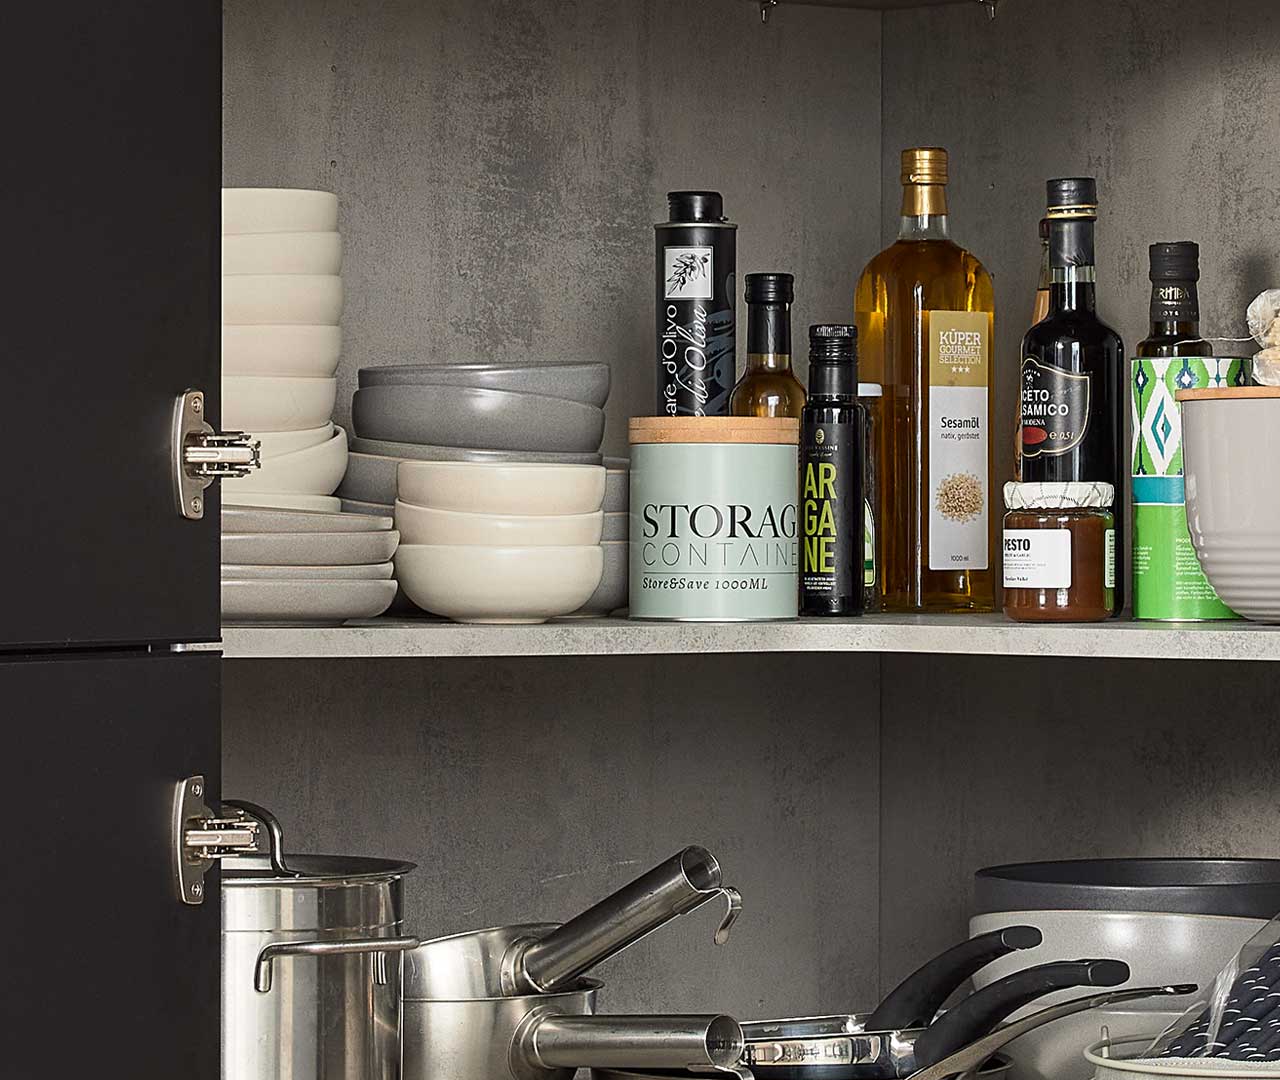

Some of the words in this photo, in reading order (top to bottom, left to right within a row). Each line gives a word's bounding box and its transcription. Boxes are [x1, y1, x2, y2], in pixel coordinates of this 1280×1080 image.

[662, 304, 678, 374] d'Olivo
[676, 304, 707, 371] Oliva
[939, 345, 981, 354] GOURMET
[939, 355, 981, 364] SELECTION
[663, 382, 677, 417] are
[1022, 389, 1050, 402] CETO
[1022, 403, 1069, 416] SAMICO
[940, 416, 980, 429] Sesamöl
[804, 462, 838, 499] AR
[642, 503, 799, 539] STORAG
[804, 499, 838, 536] GA
[642, 542, 799, 566] CONTAINE
[804, 536, 837, 573] NE
[642, 577, 710, 590] Store&Save
[715, 578, 769, 590] 1000ML
